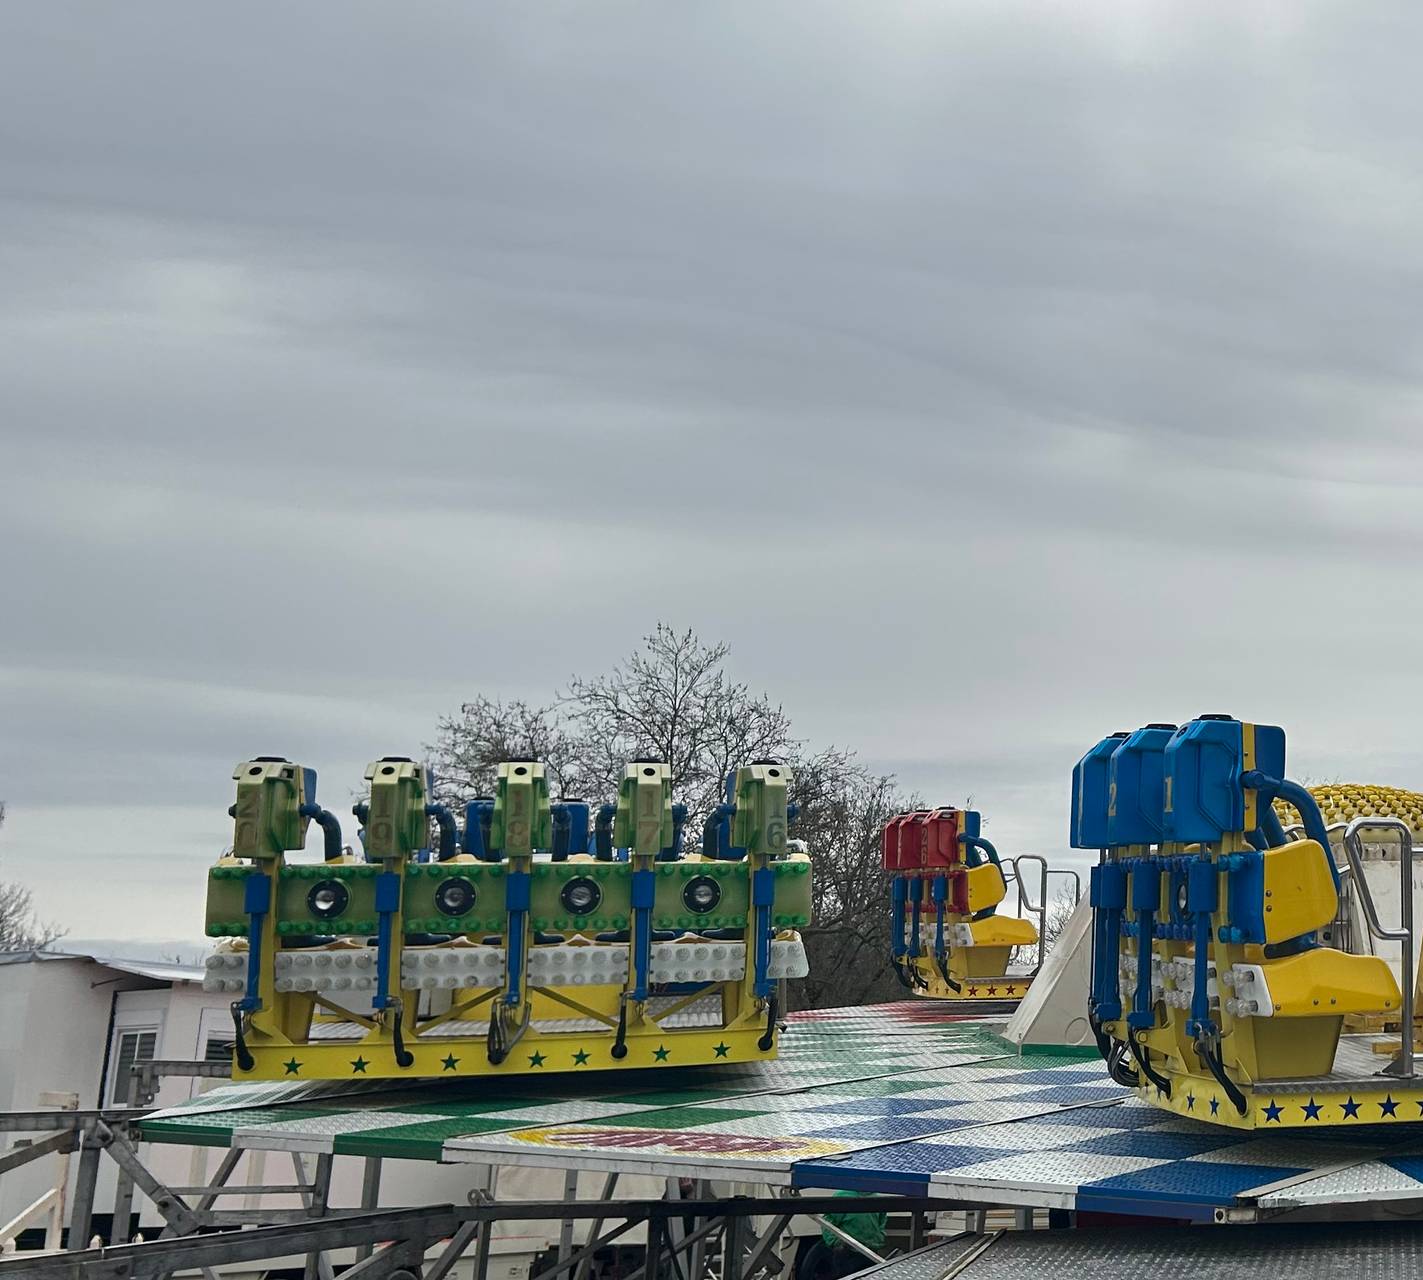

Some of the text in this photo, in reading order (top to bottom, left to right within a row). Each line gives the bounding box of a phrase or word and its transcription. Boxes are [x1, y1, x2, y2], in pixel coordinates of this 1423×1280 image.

[507, 790, 528, 848] 18
[638, 791, 660, 848] 17
[767, 790, 786, 849] 16
[1108, 783, 1117, 817] 2
[1164, 776, 1174, 813] 1
